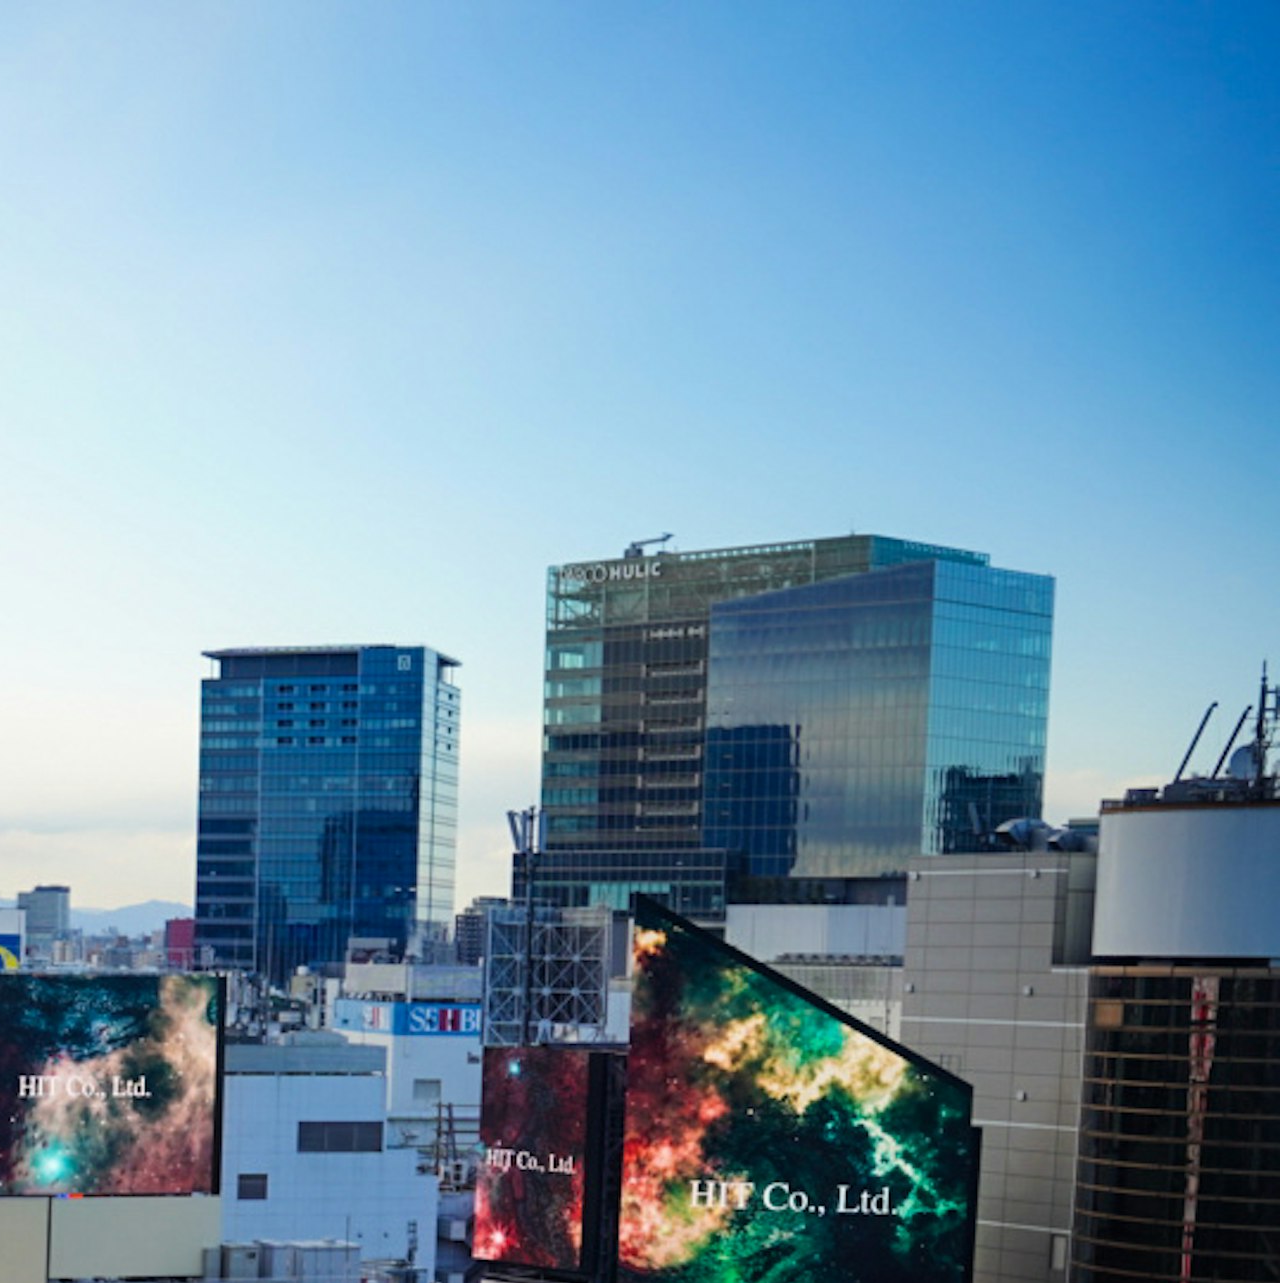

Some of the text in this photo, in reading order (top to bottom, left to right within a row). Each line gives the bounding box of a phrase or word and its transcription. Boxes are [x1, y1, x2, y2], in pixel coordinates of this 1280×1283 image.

[609, 562, 661, 581] HULIC
[19, 1074, 153, 1100] HIT Co., Ltd.
[487, 1149, 515, 1169] HIT
[548, 1154, 577, 1175] Ltd.
[690, 1179, 899, 1217] HIT Co., Ltd.
